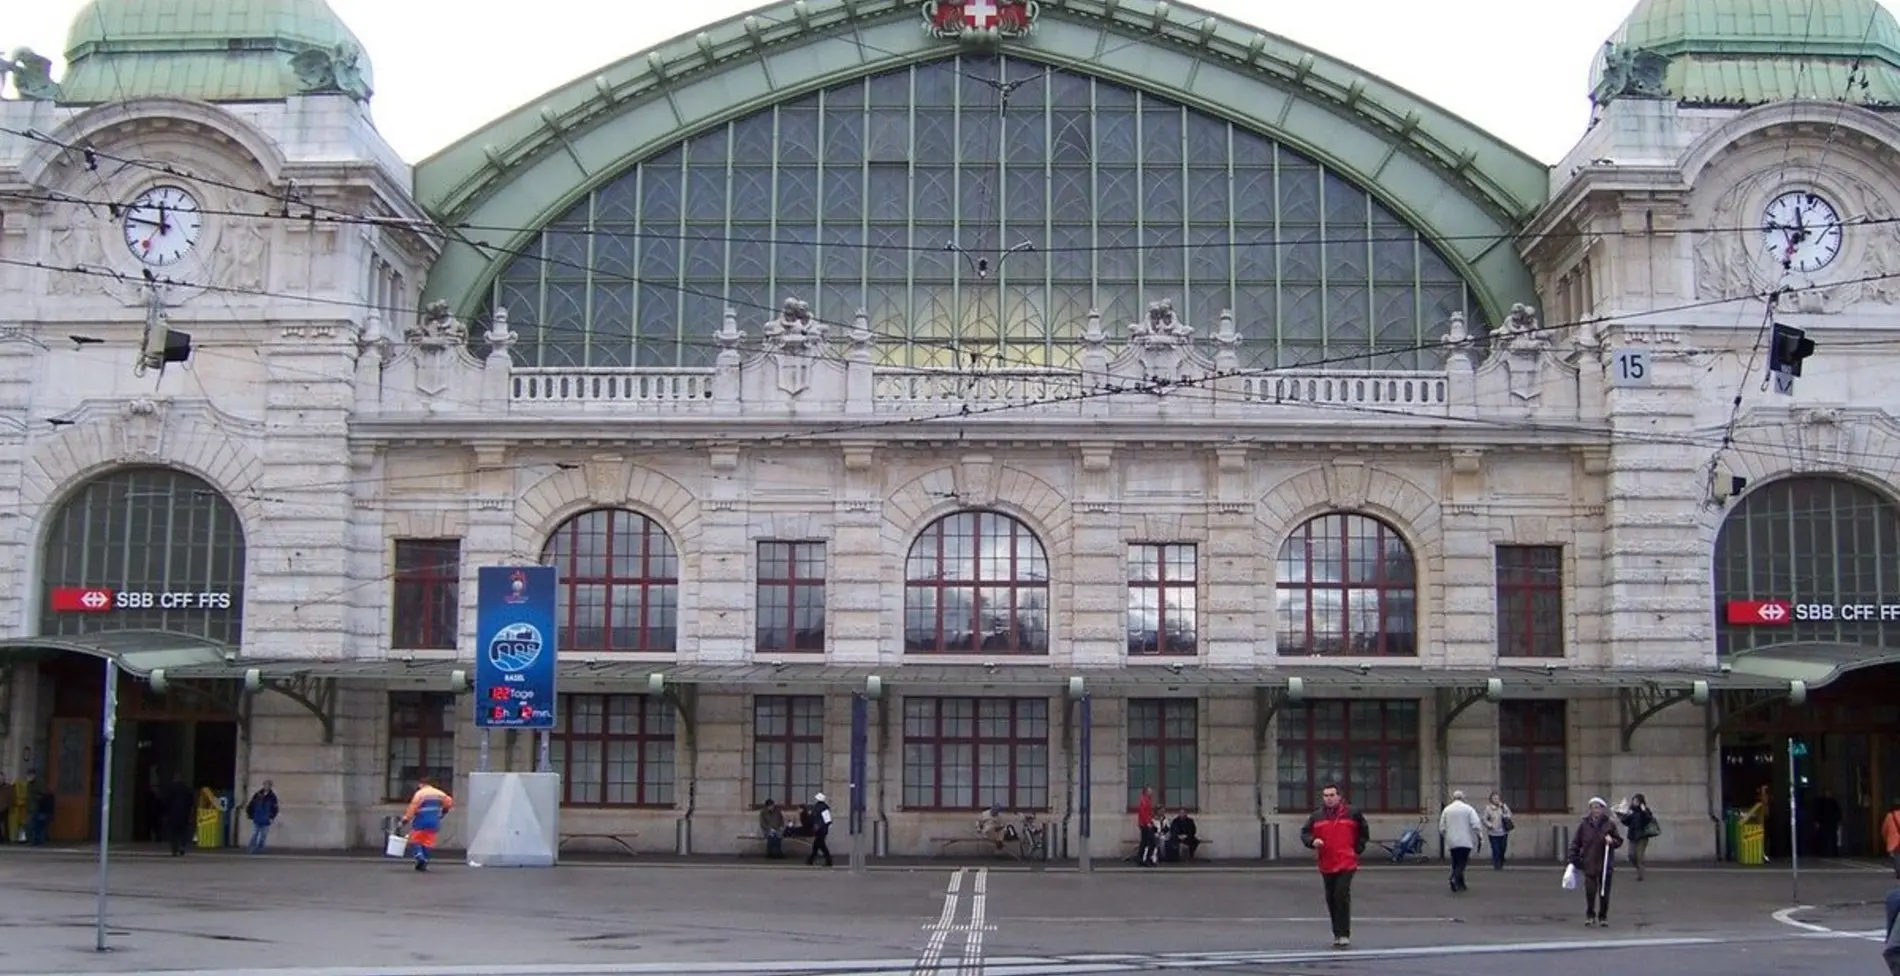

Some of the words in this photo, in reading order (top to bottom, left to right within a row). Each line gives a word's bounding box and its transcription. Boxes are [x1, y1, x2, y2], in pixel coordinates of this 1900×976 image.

[1620, 353, 1644, 379] 15
[116, 591, 154, 608] SBB
[160, 591, 193, 608] CFF
[198, 592, 231, 608] FFS
[1795, 604, 1833, 620] SBB
[1841, 604, 1873, 620] CFF
[510, 688, 534, 699] Tage
